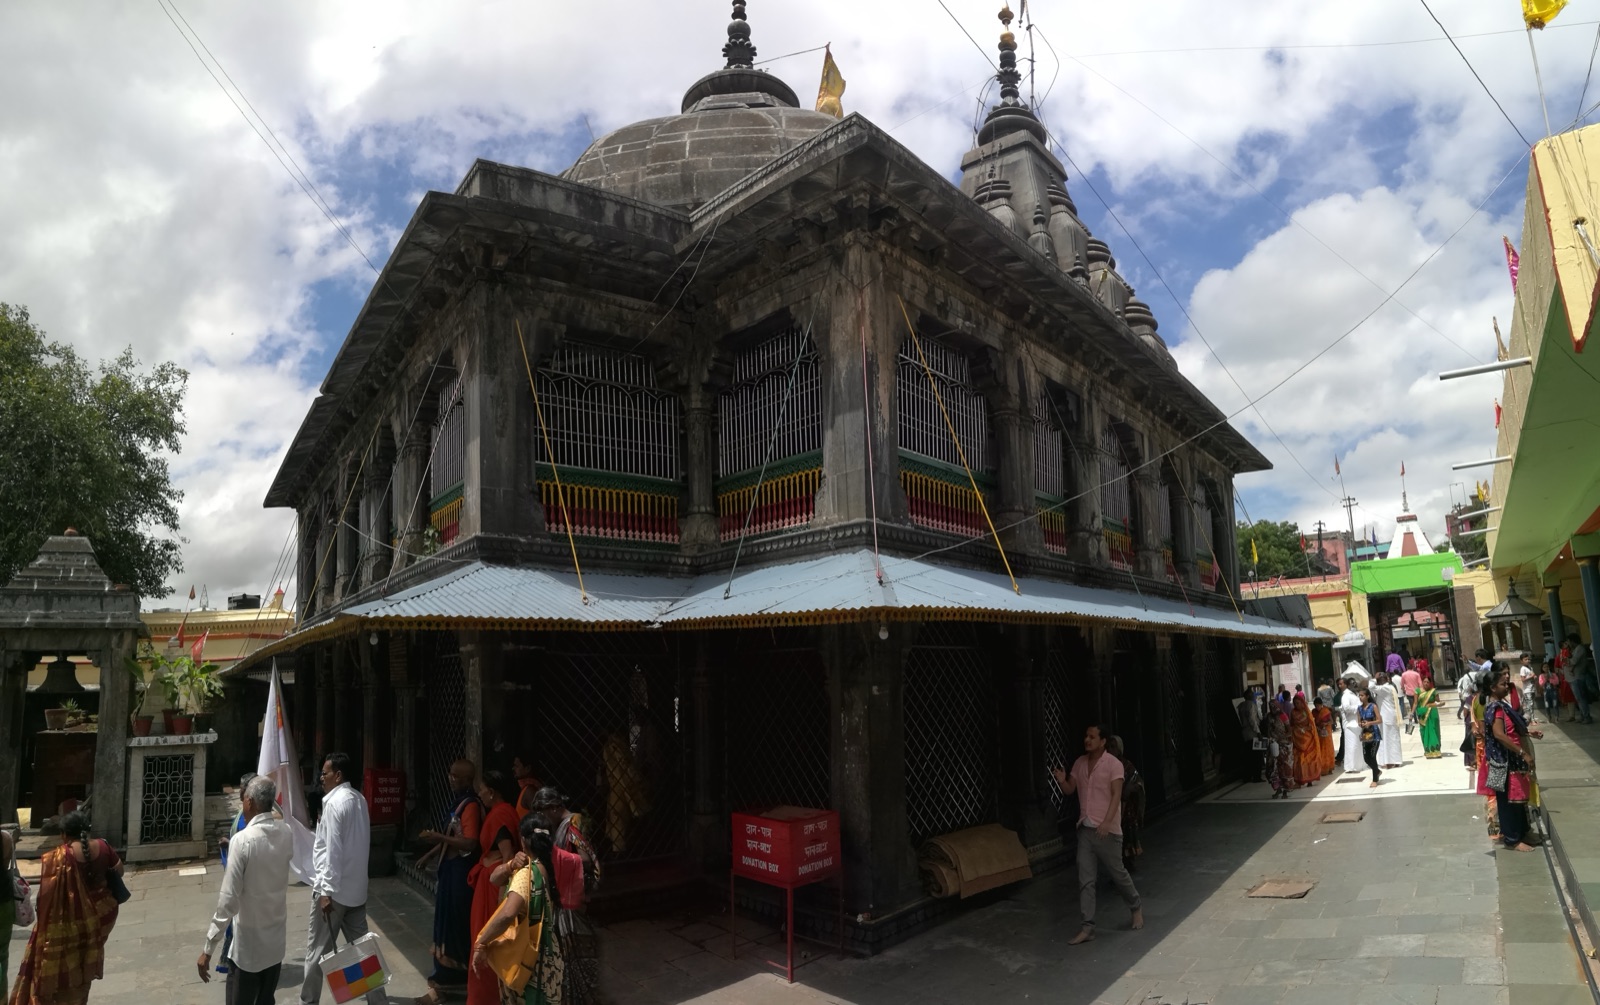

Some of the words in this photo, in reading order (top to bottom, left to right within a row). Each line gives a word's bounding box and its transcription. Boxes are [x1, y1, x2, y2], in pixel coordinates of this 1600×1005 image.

[742, 856, 767, 870] DONATION
[768, 862, 779, 874] BOX
[798, 860, 822, 876] DONATION
[823, 856, 833, 868] BOX
